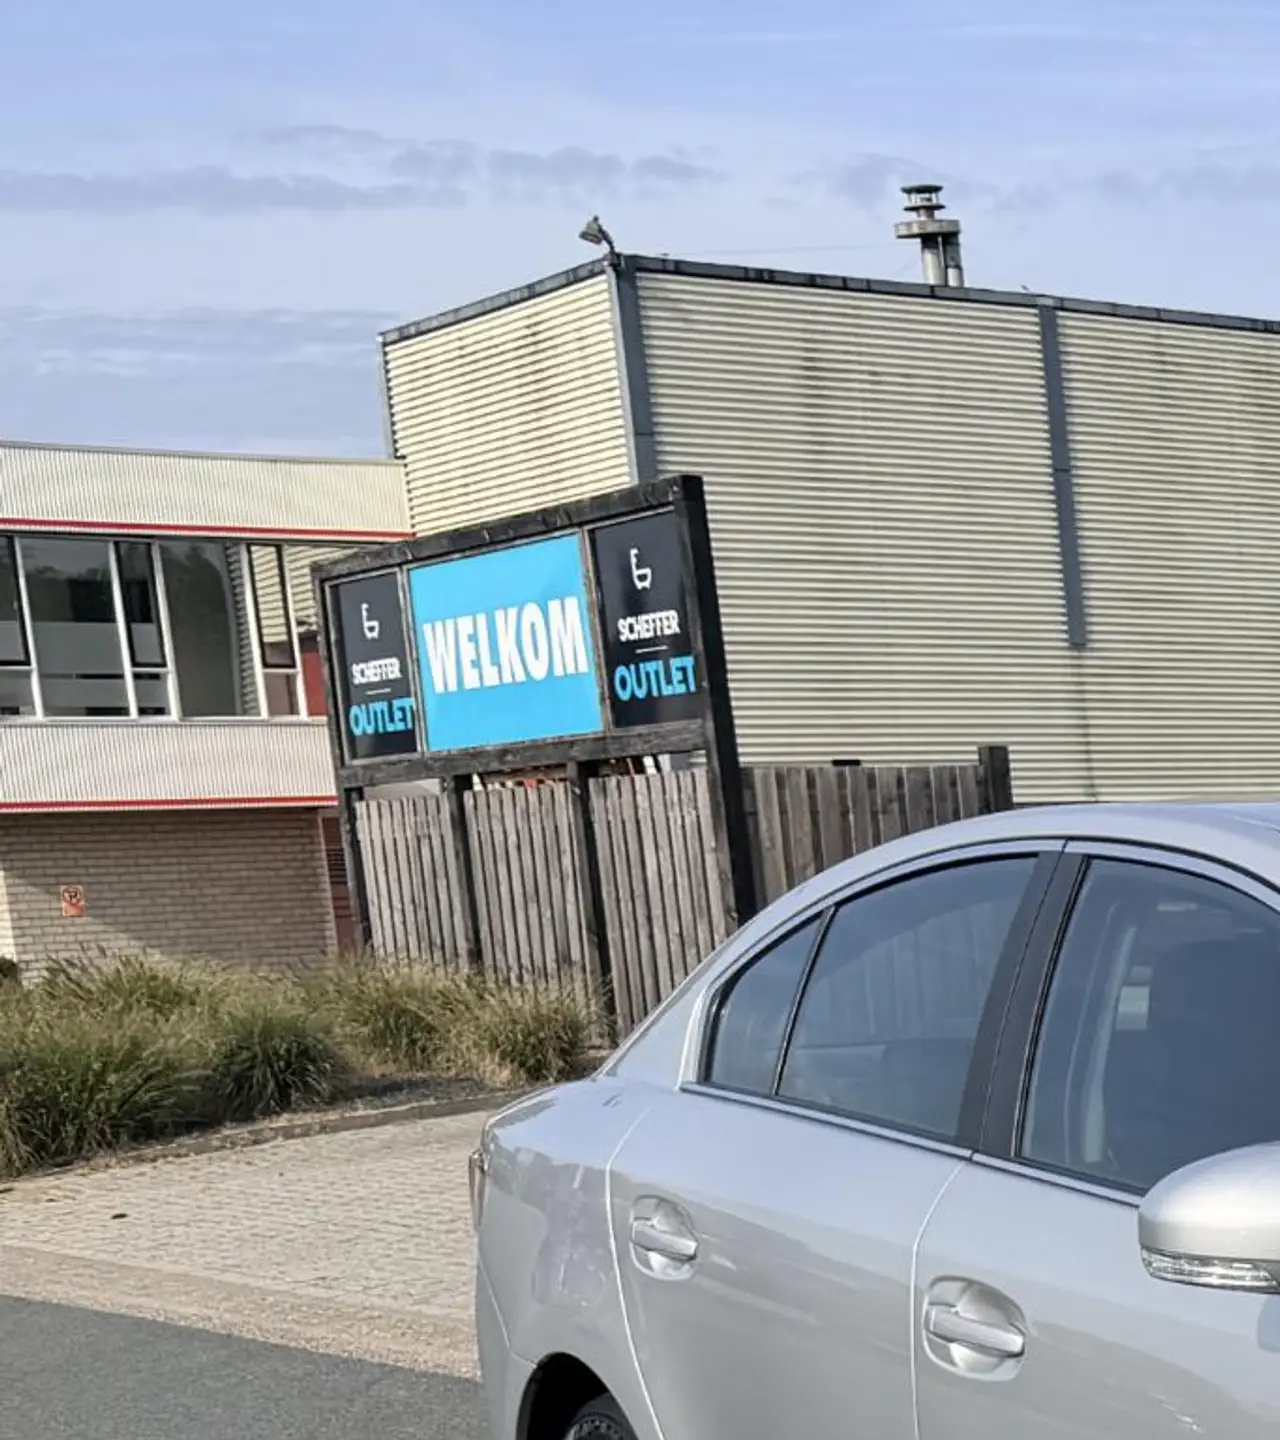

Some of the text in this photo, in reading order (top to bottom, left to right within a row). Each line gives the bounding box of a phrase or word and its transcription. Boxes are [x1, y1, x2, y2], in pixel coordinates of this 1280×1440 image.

[422, 595, 589, 694] WELKOM
[617, 609, 681, 642] SCHEFFER
[352, 656, 402, 685] SCHEFFER
[614, 655, 696, 701] OUTLET
[349, 696, 414, 736] OUTLET
